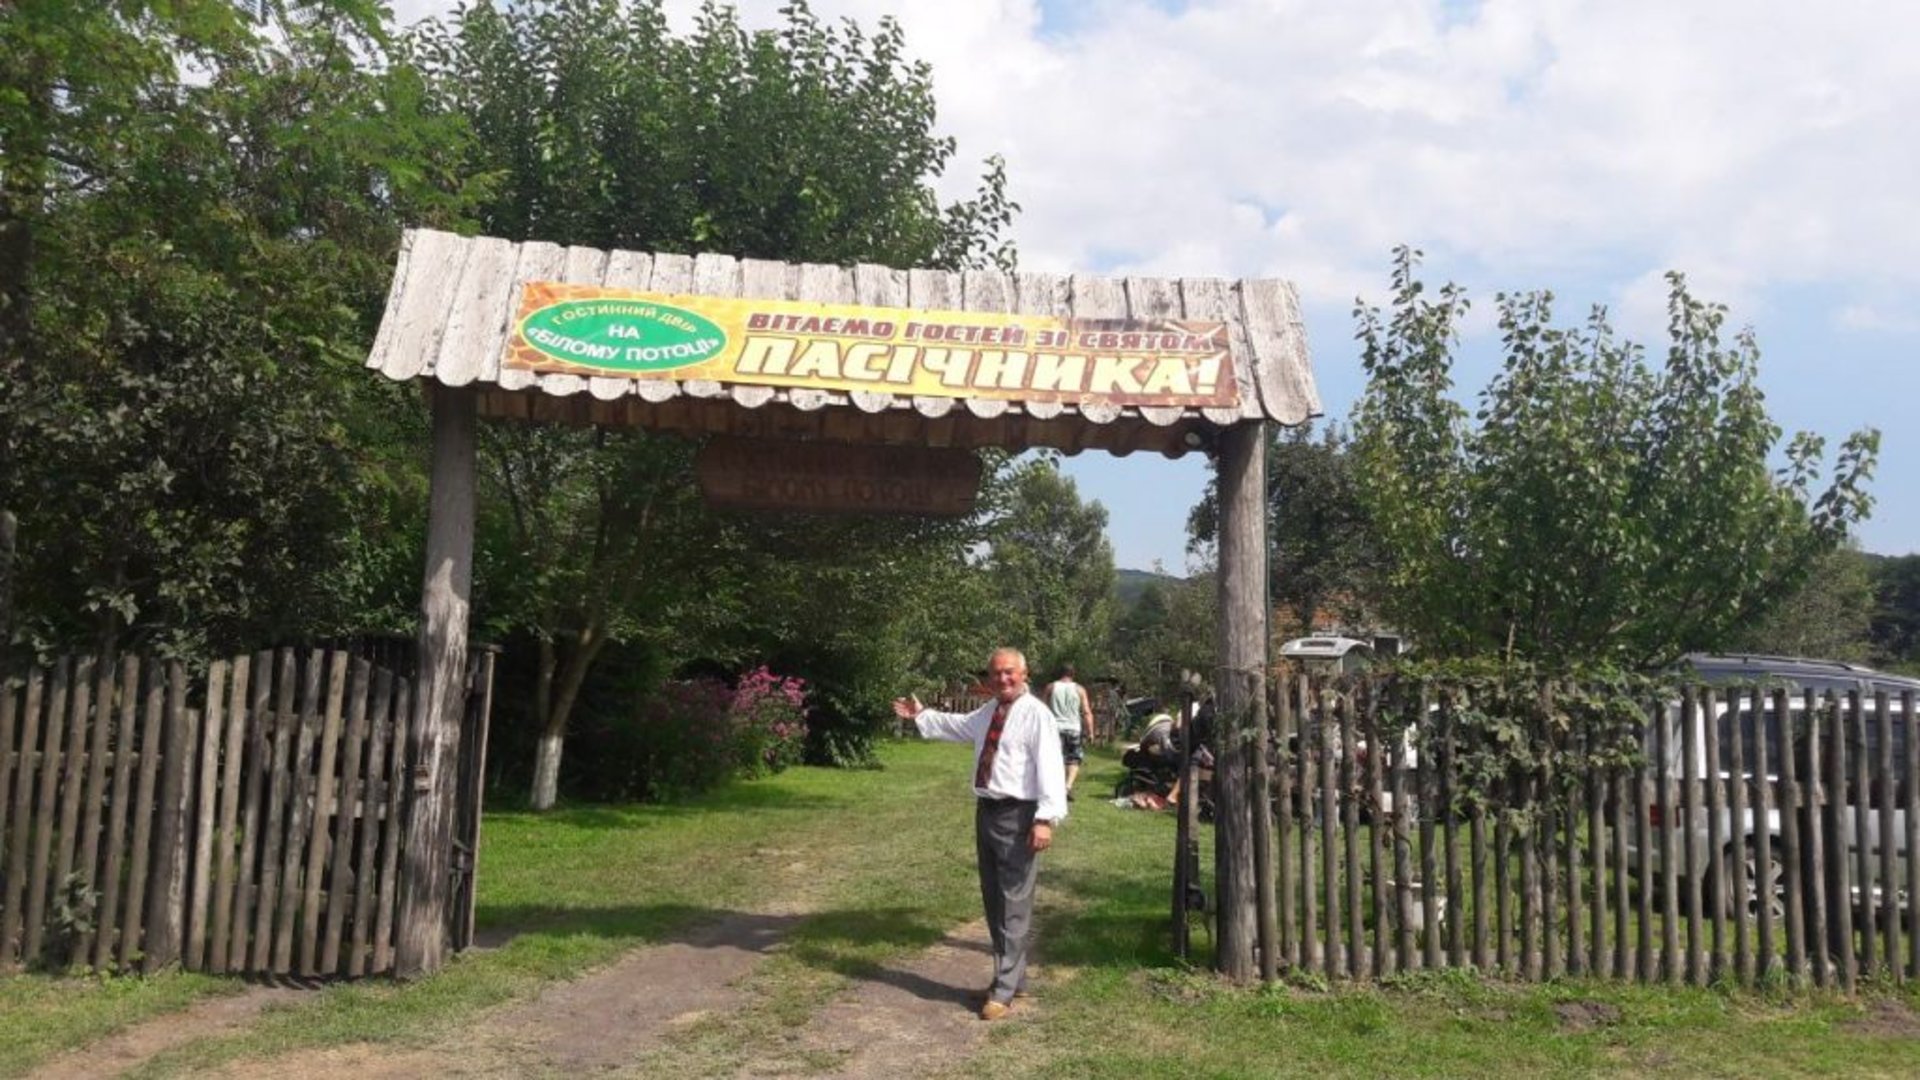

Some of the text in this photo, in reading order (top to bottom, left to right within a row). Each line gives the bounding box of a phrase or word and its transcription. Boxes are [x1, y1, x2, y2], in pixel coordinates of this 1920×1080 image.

[552, 303, 657, 325] ГОСТИННИЙ
[608, 324, 640, 340] НА
[905, 322, 1025, 346] ГОСТЕЙ
[1035, 330, 1068, 347] ЗІ
[1079, 330, 1214, 351] СВЯТОМ
[734, 336, 1221, 395] ПАСІЧНИКА!
